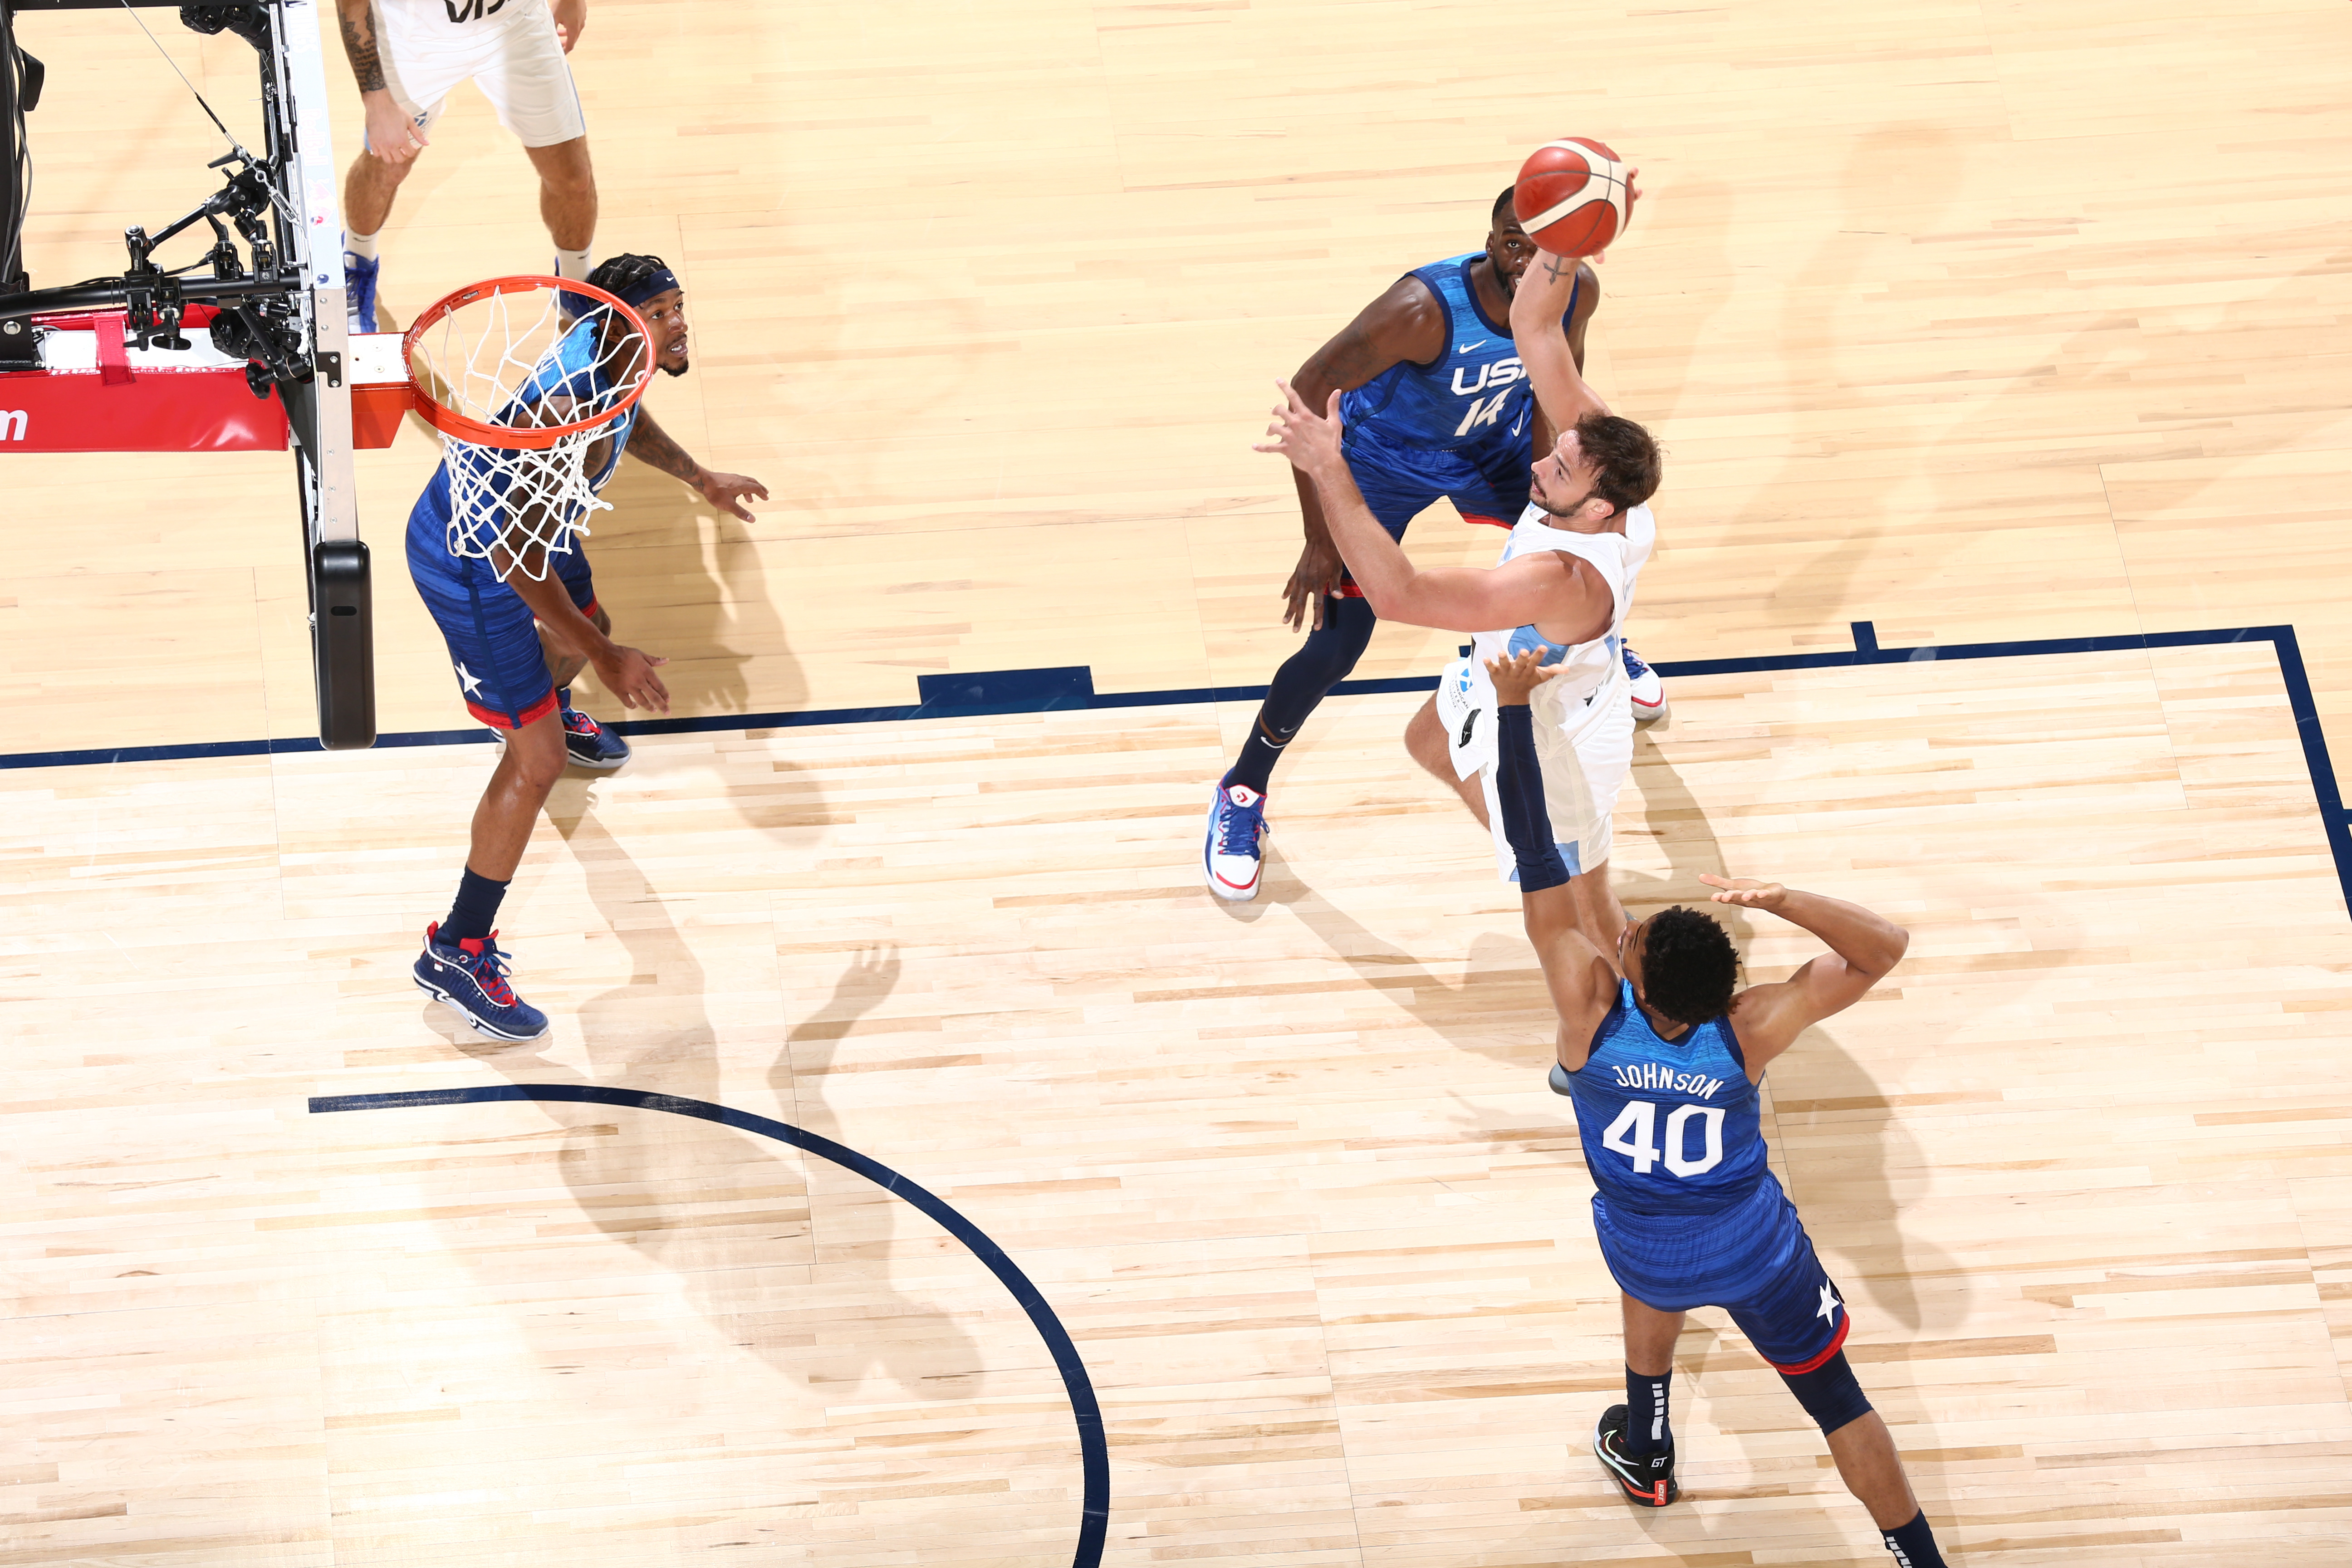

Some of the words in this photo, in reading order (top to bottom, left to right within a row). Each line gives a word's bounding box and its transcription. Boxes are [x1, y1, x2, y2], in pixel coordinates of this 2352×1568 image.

[1454, 384, 1518, 436] 14
[1612, 1063, 1724, 1101] JOHNSON
[1602, 1100, 1725, 1178] 40
[1651, 1456, 1668, 1468] GT
